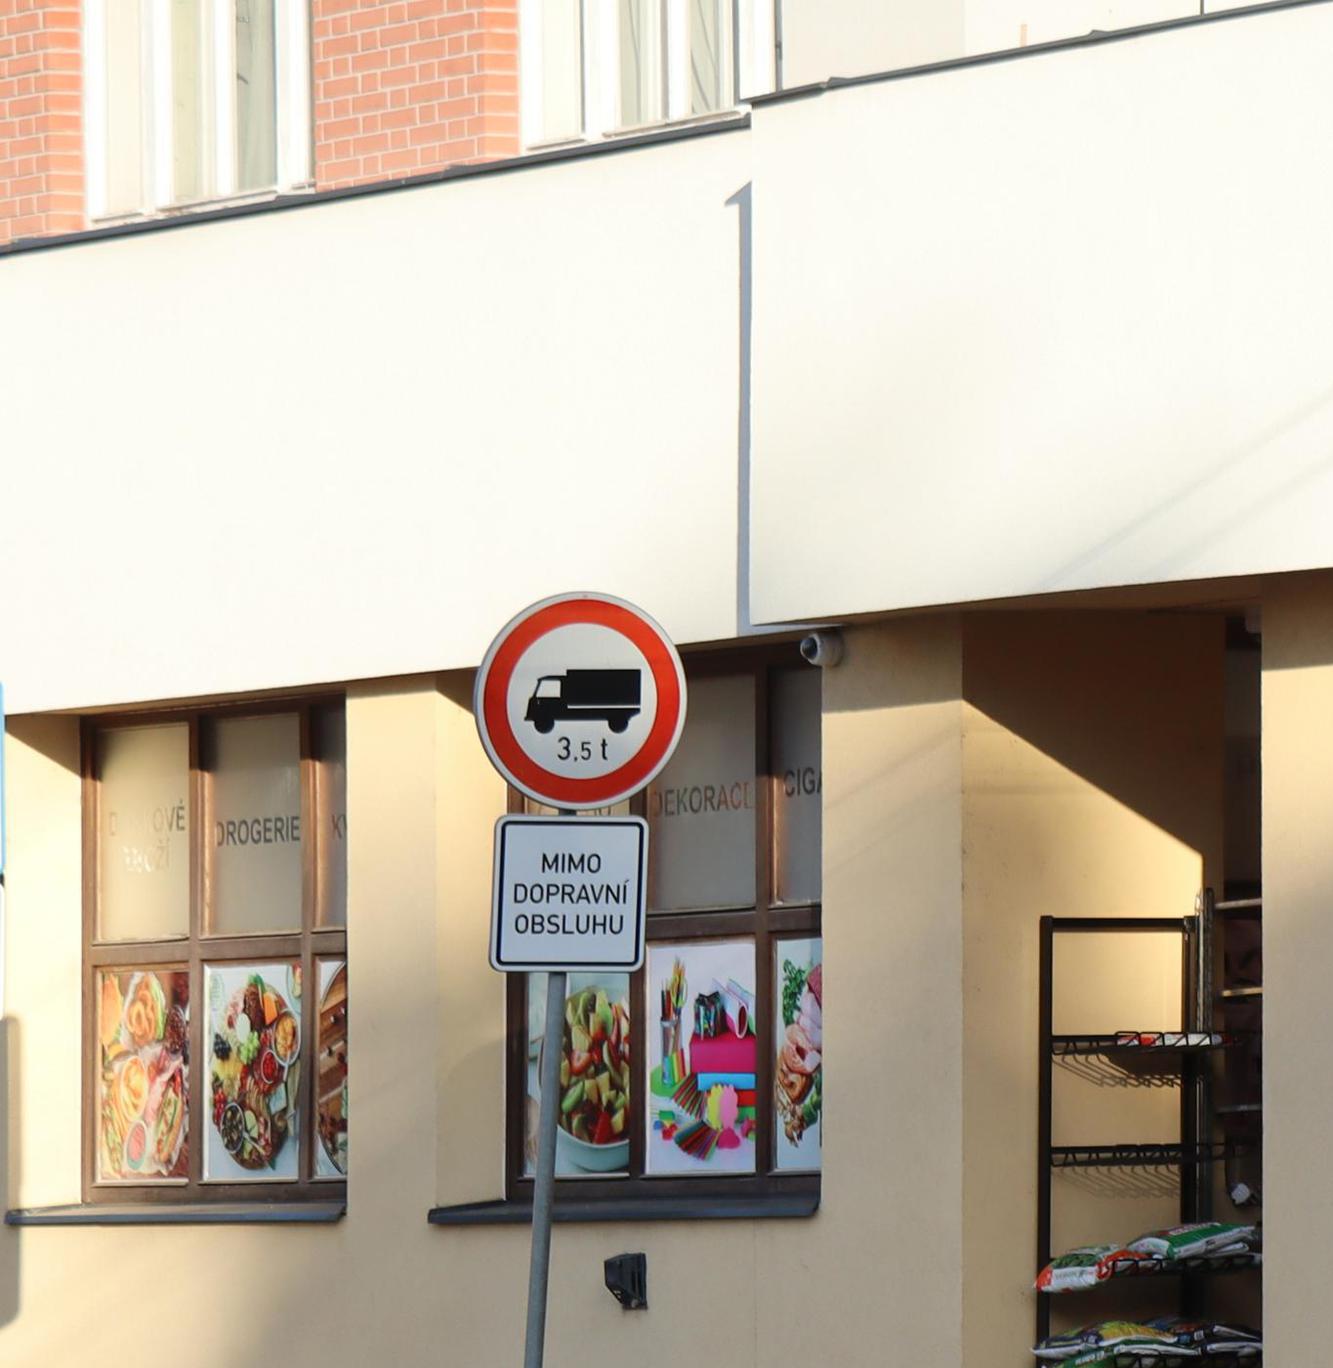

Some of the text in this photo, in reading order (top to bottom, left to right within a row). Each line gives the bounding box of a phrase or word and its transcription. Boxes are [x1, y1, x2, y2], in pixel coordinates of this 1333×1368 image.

[557, 736, 609, 763] 3,5 t
[216, 816, 301, 847] DROGERIE
[541, 853, 602, 874] MIMO
[513, 879, 629, 905] DOPRAVNÍ
[514, 914, 625, 935] OBSLUHU
